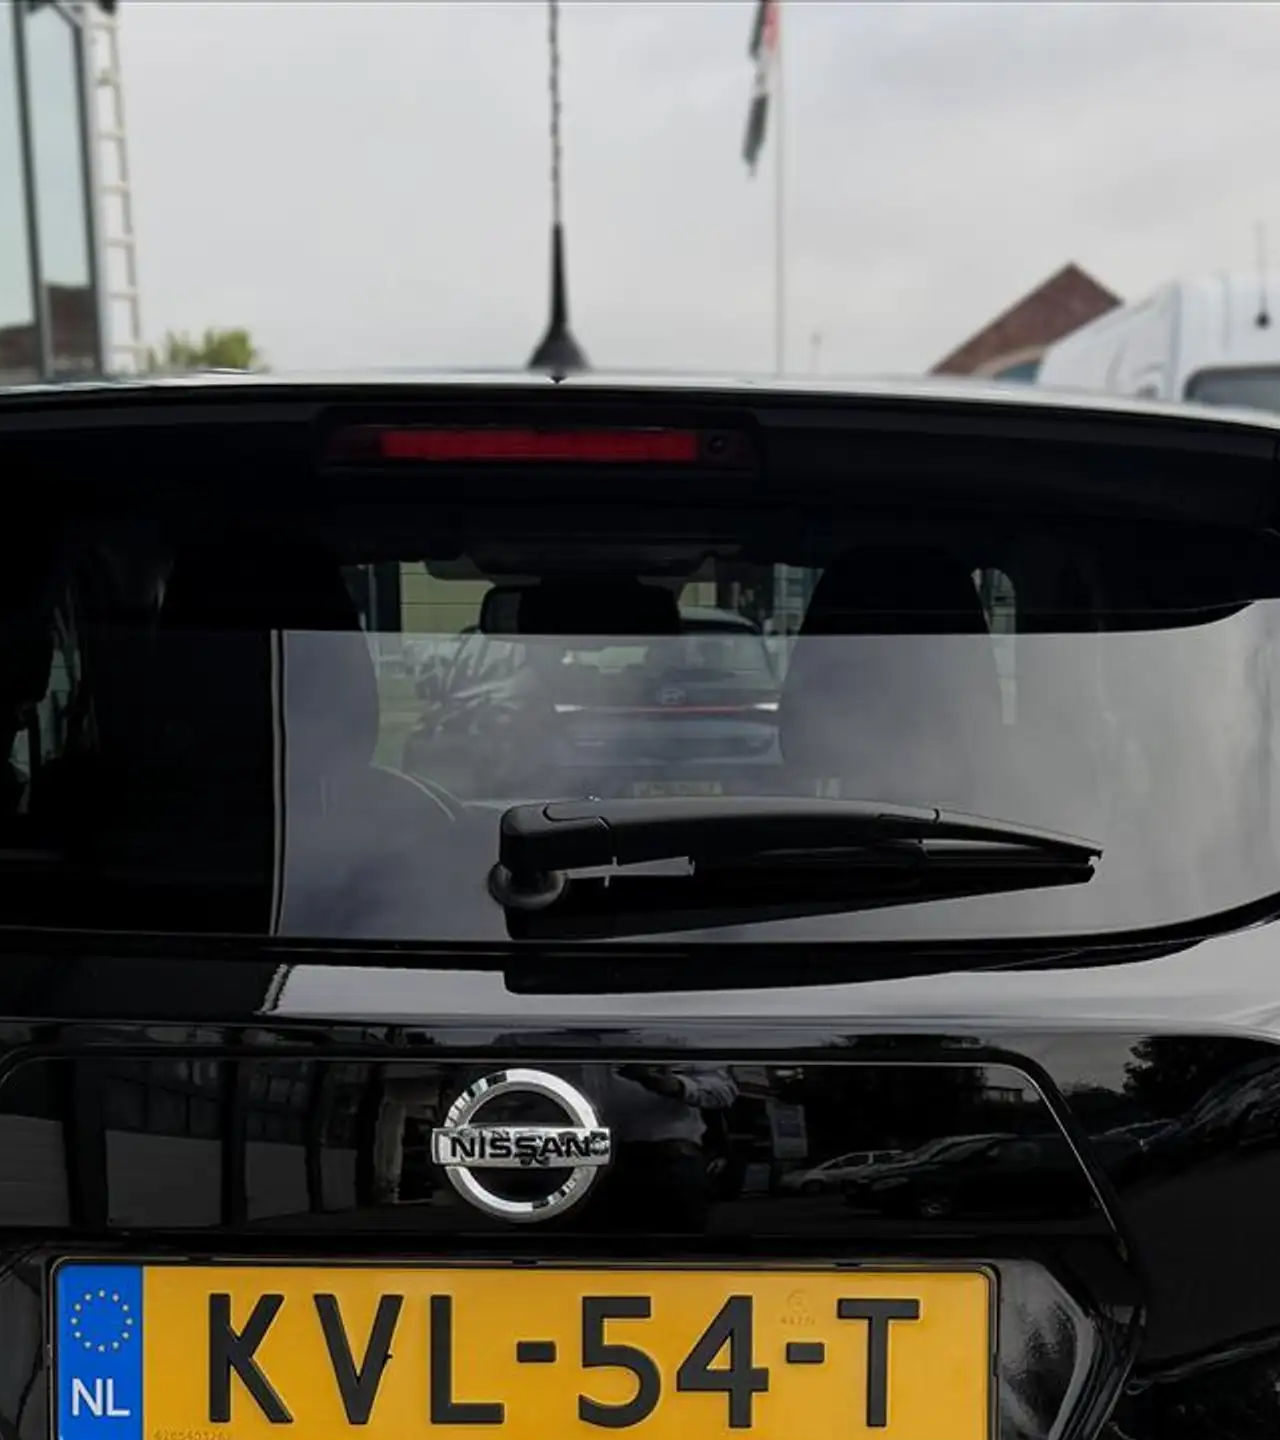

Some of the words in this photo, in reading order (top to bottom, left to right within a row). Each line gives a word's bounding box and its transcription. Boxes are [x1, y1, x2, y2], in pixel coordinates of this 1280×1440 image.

[450, 1131, 592, 1159] NISSAN
[208, 1293, 920, 1428] KVL-54-T
[71, 1377, 130, 1416] NL
